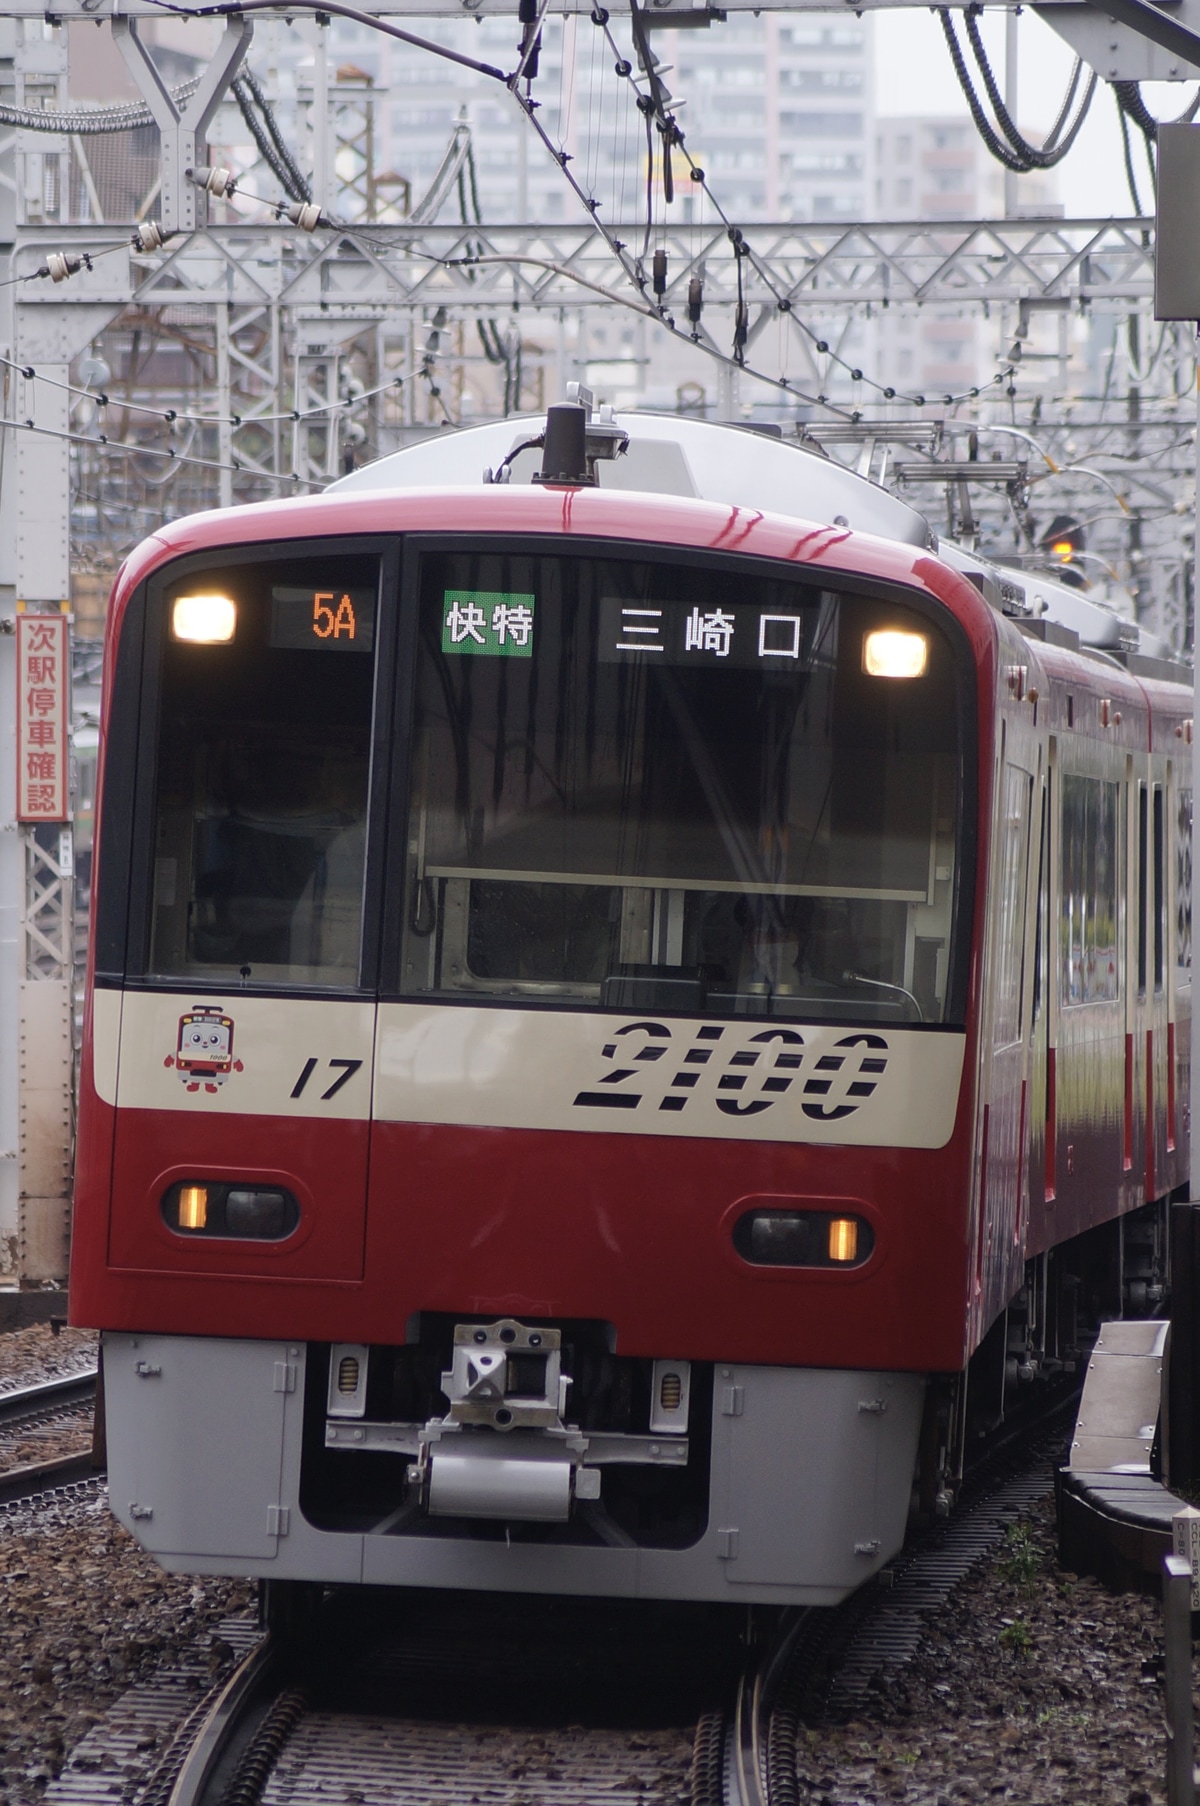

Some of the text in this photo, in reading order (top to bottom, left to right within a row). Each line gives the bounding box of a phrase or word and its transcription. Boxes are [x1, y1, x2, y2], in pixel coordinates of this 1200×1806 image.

[313, 593, 356, 640] 5A
[446, 600, 533, 646] 快特
[616, 606, 801, 658] 三崎口
[27, 623, 57, 812] 次駅停車確認
[289, 1057, 364, 1100] 17
[572, 1022, 889, 1120] 2100
